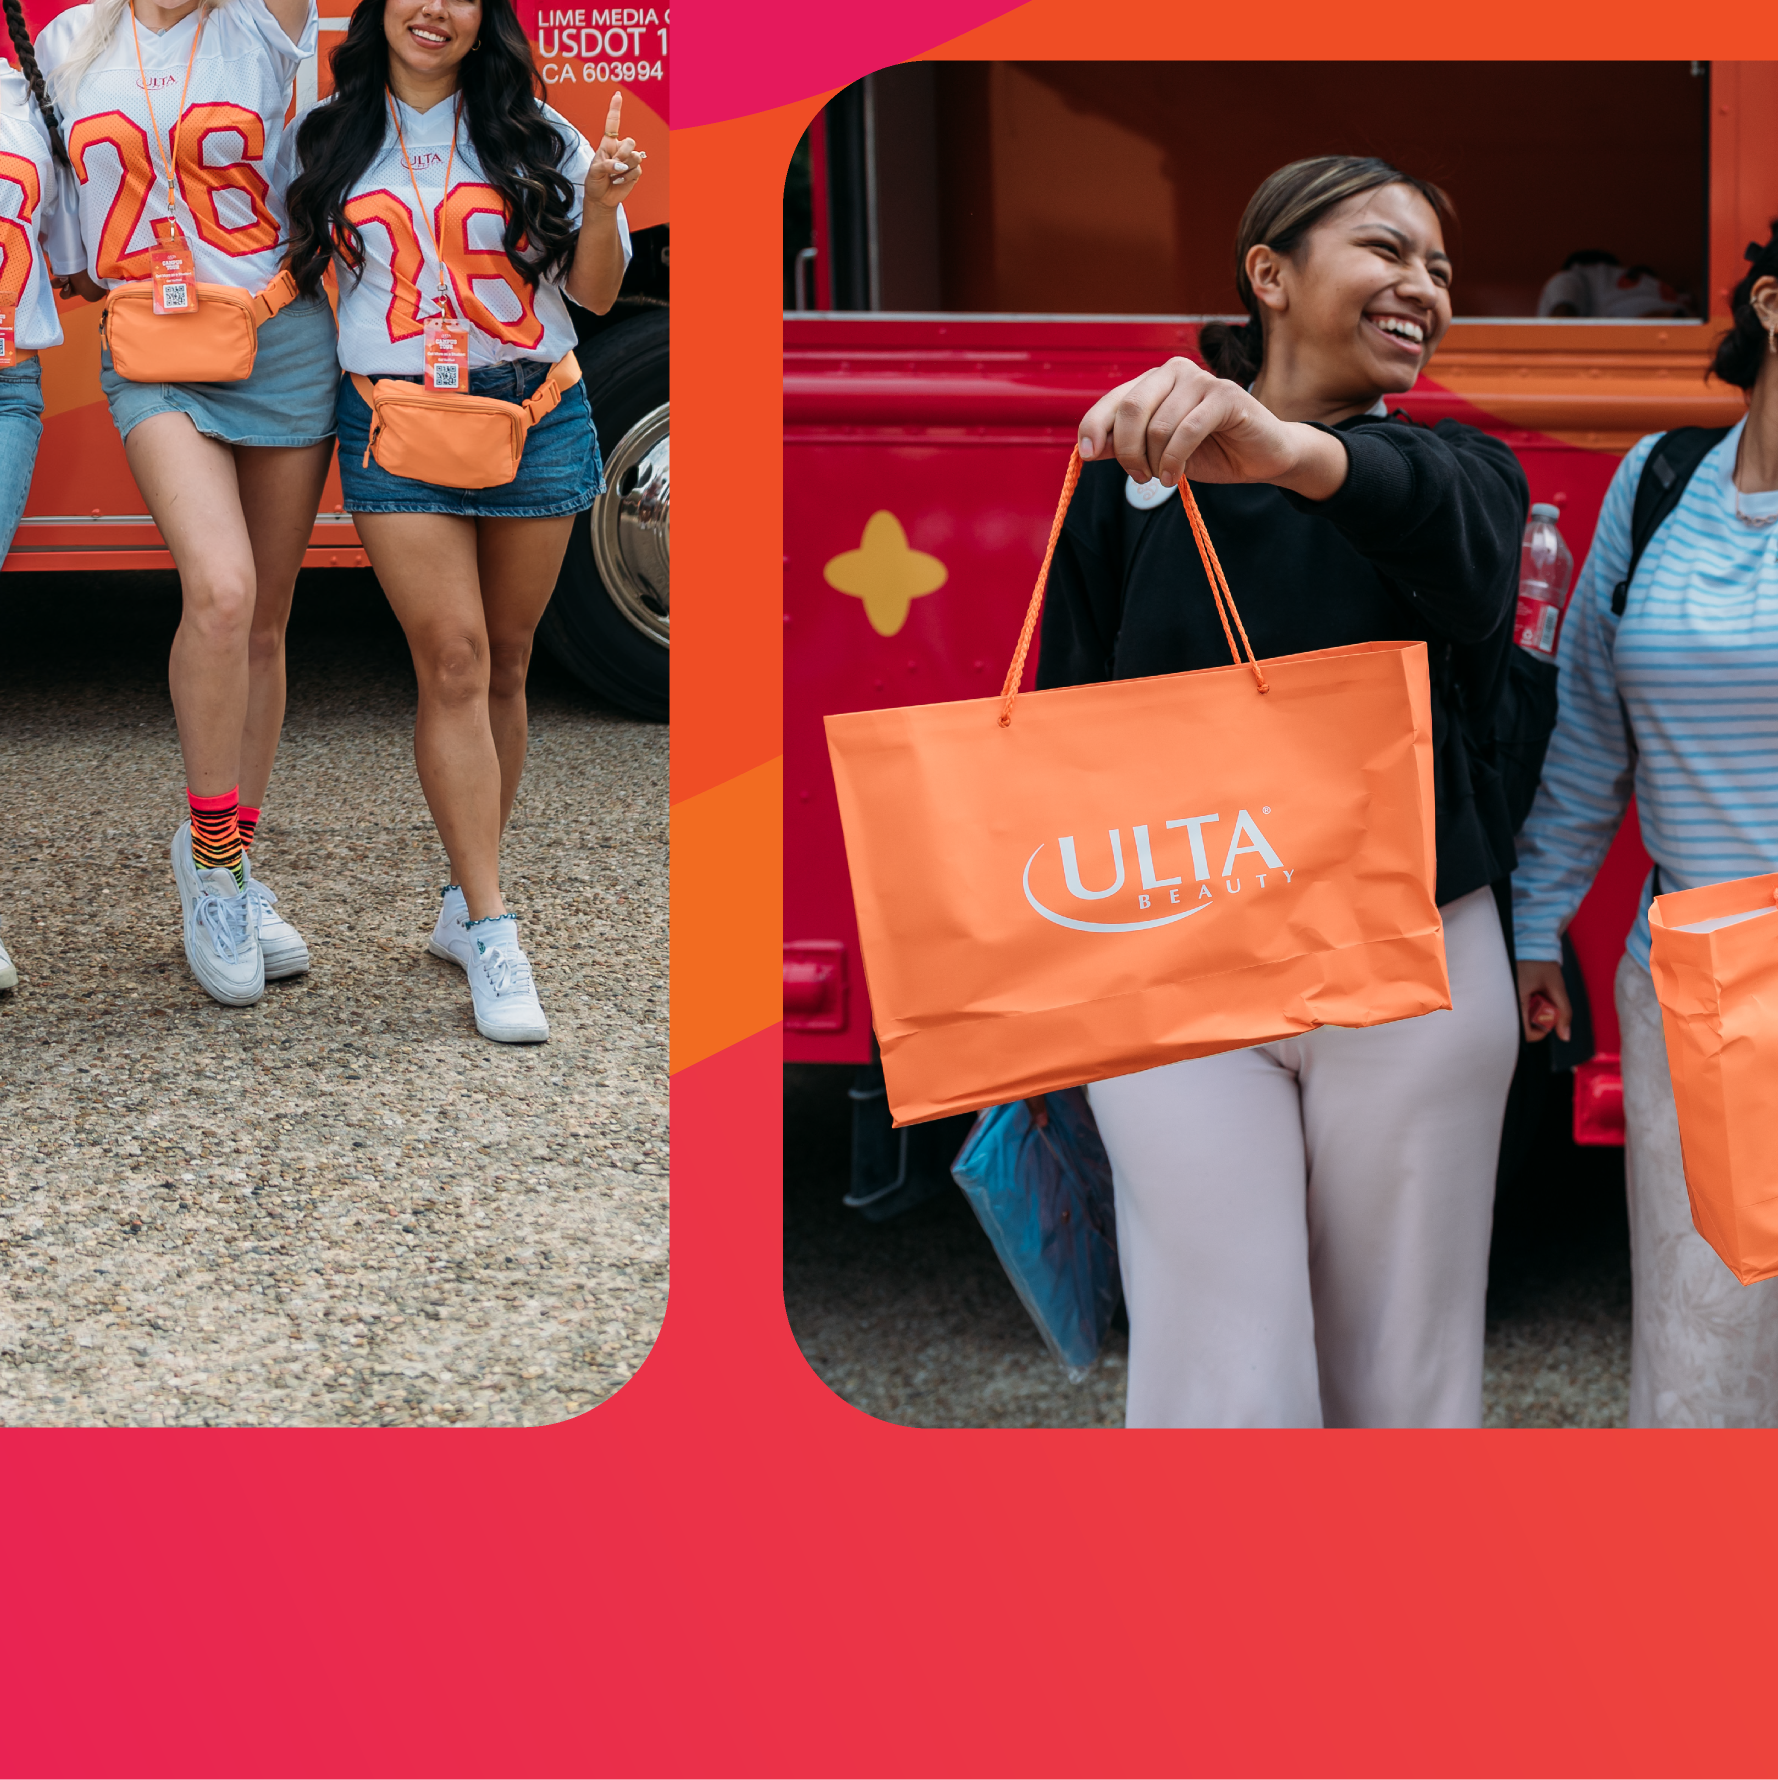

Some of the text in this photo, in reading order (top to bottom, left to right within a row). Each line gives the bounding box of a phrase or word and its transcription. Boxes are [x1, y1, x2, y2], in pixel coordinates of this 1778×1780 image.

[538, 8, 586, 28] LIME
[592, 7, 659, 27] MEDIA
[538, 27, 647, 59] USDOT
[542, 59, 664, 84] CA 603994
[68, 101, 280, 281] 26
[331, 182, 545, 350] 26
[1057, 809, 1285, 901] ULTA
[1137, 868, 1296, 910] BEAUTY
